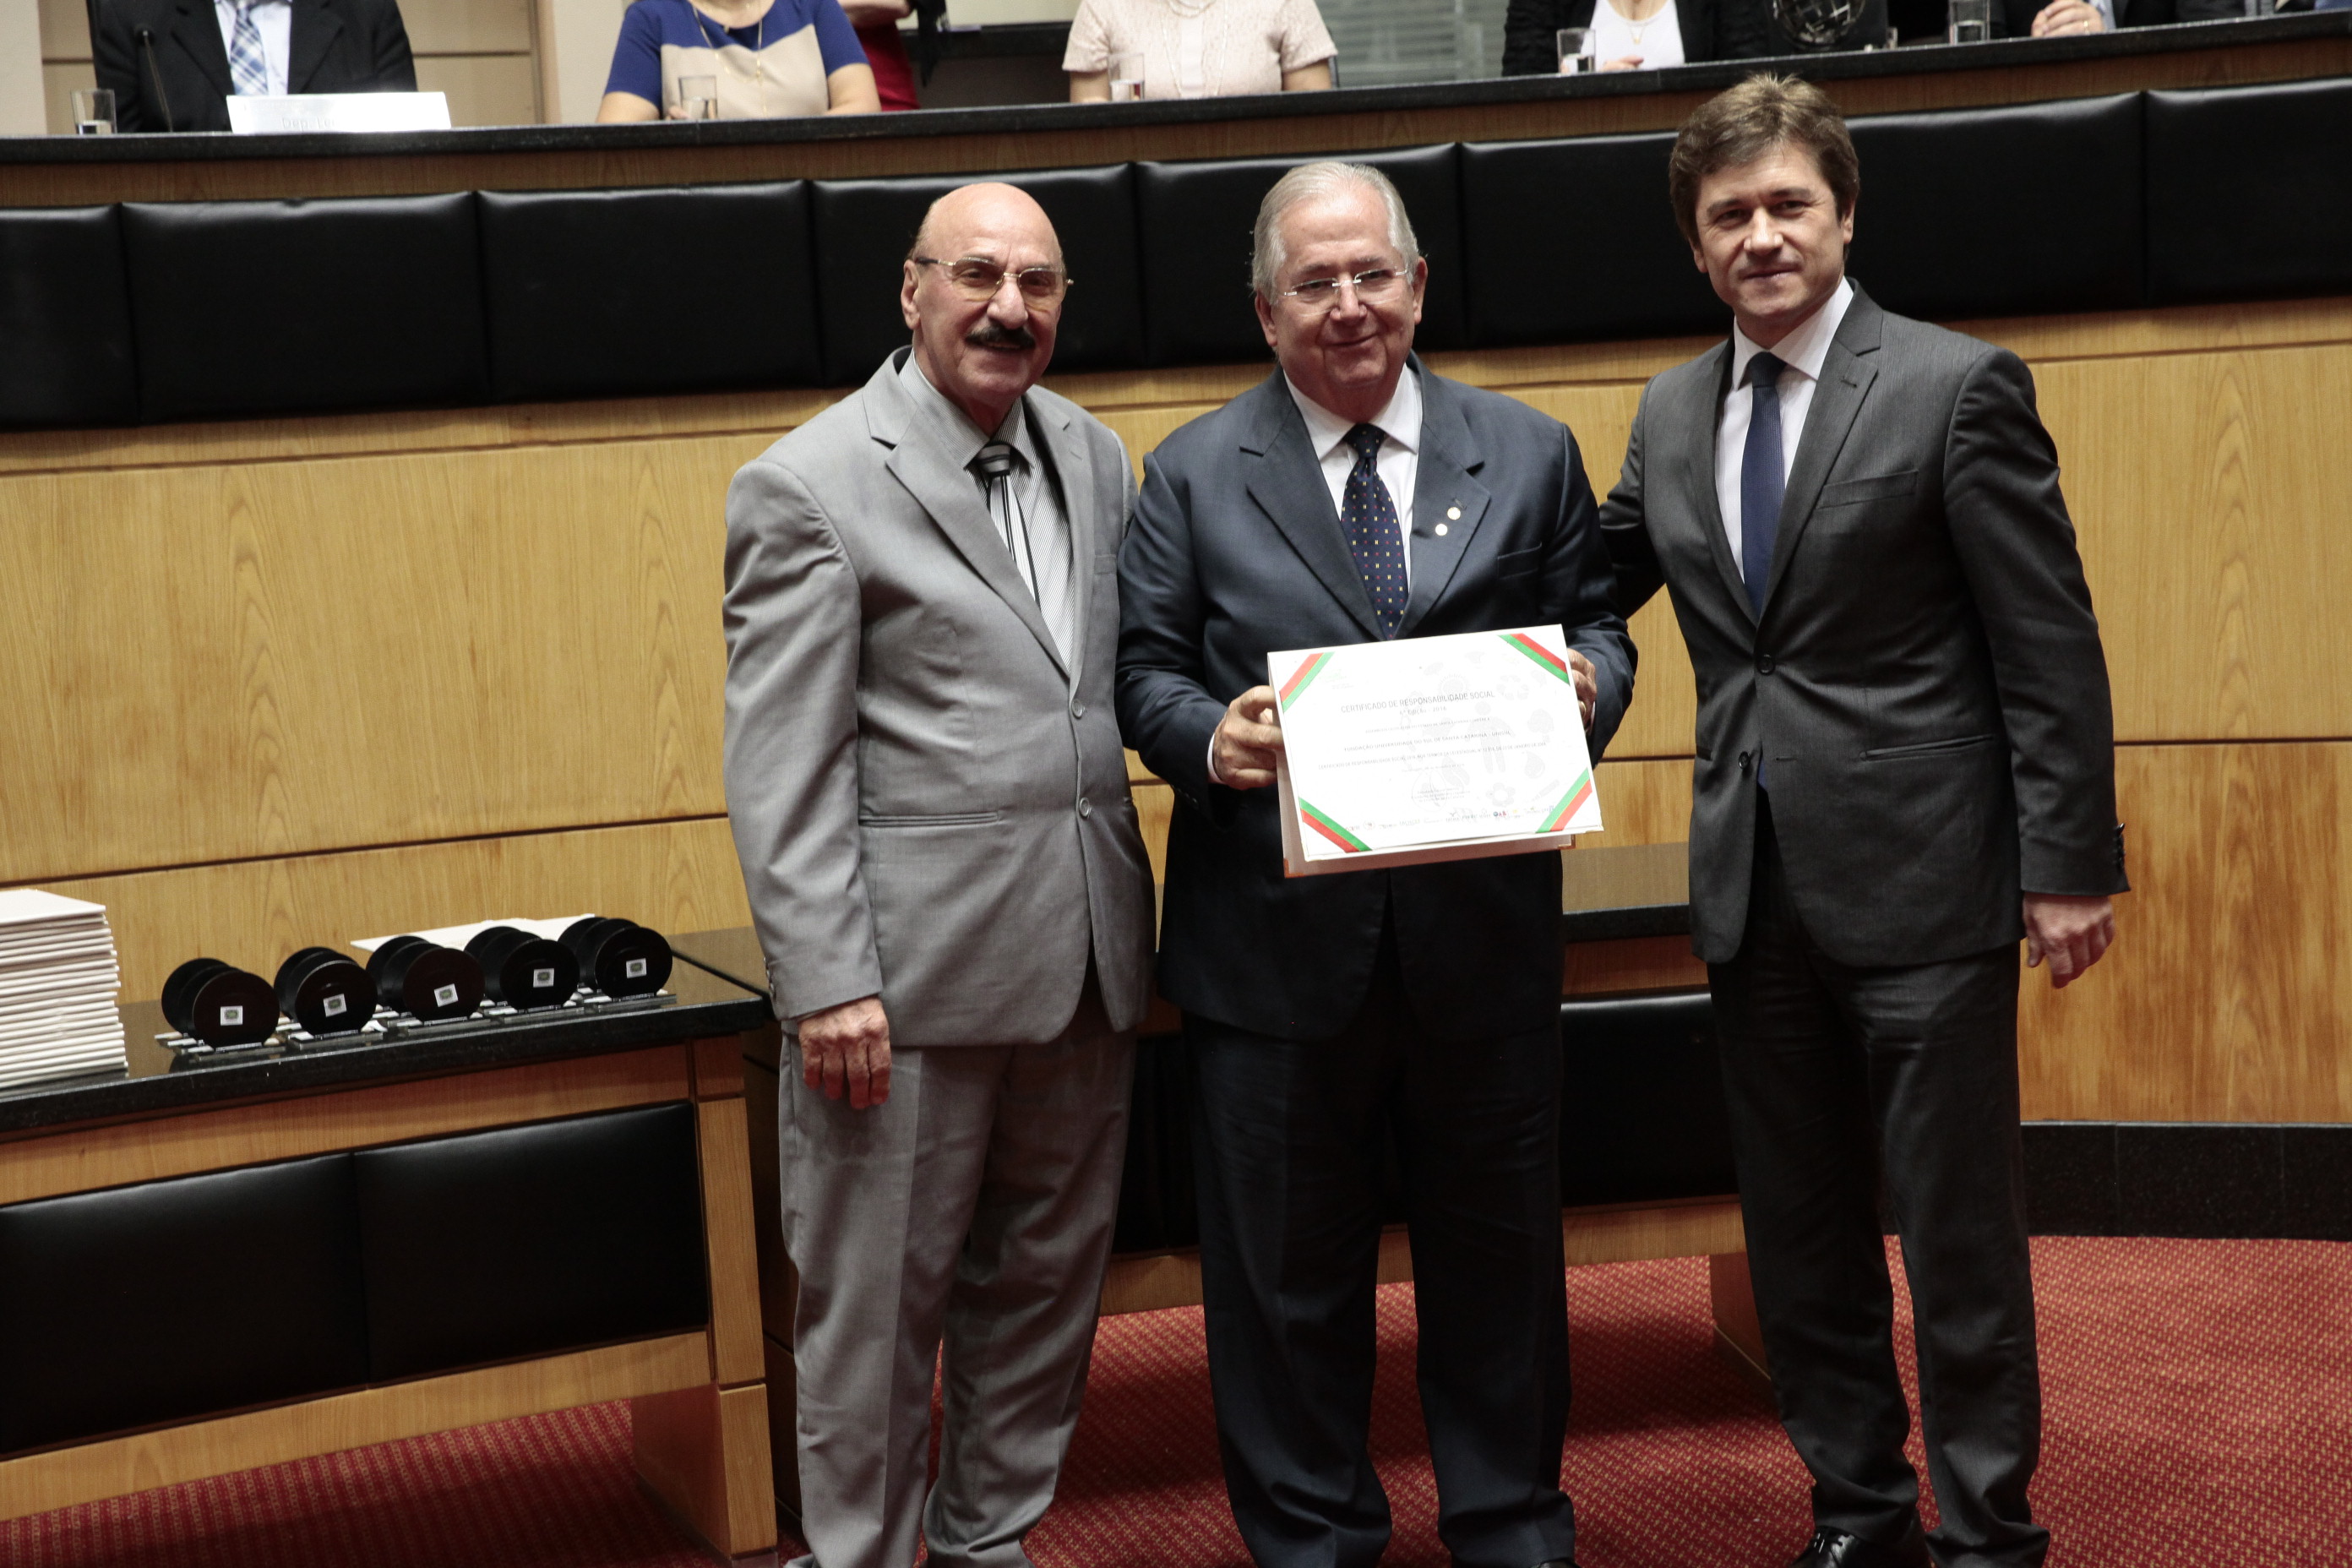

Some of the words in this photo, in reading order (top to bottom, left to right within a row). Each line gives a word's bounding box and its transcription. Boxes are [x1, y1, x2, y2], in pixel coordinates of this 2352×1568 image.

[1341, 701, 1387, 713] CERTIFICADO
[1388, 700, 1398, 708] DE
[1400, 693, 1468, 707] RESPONSABILIDADE
[1469, 689, 1495, 700] SOCIAL
[1375, 740, 1413, 749] UNIVERSIDADE
